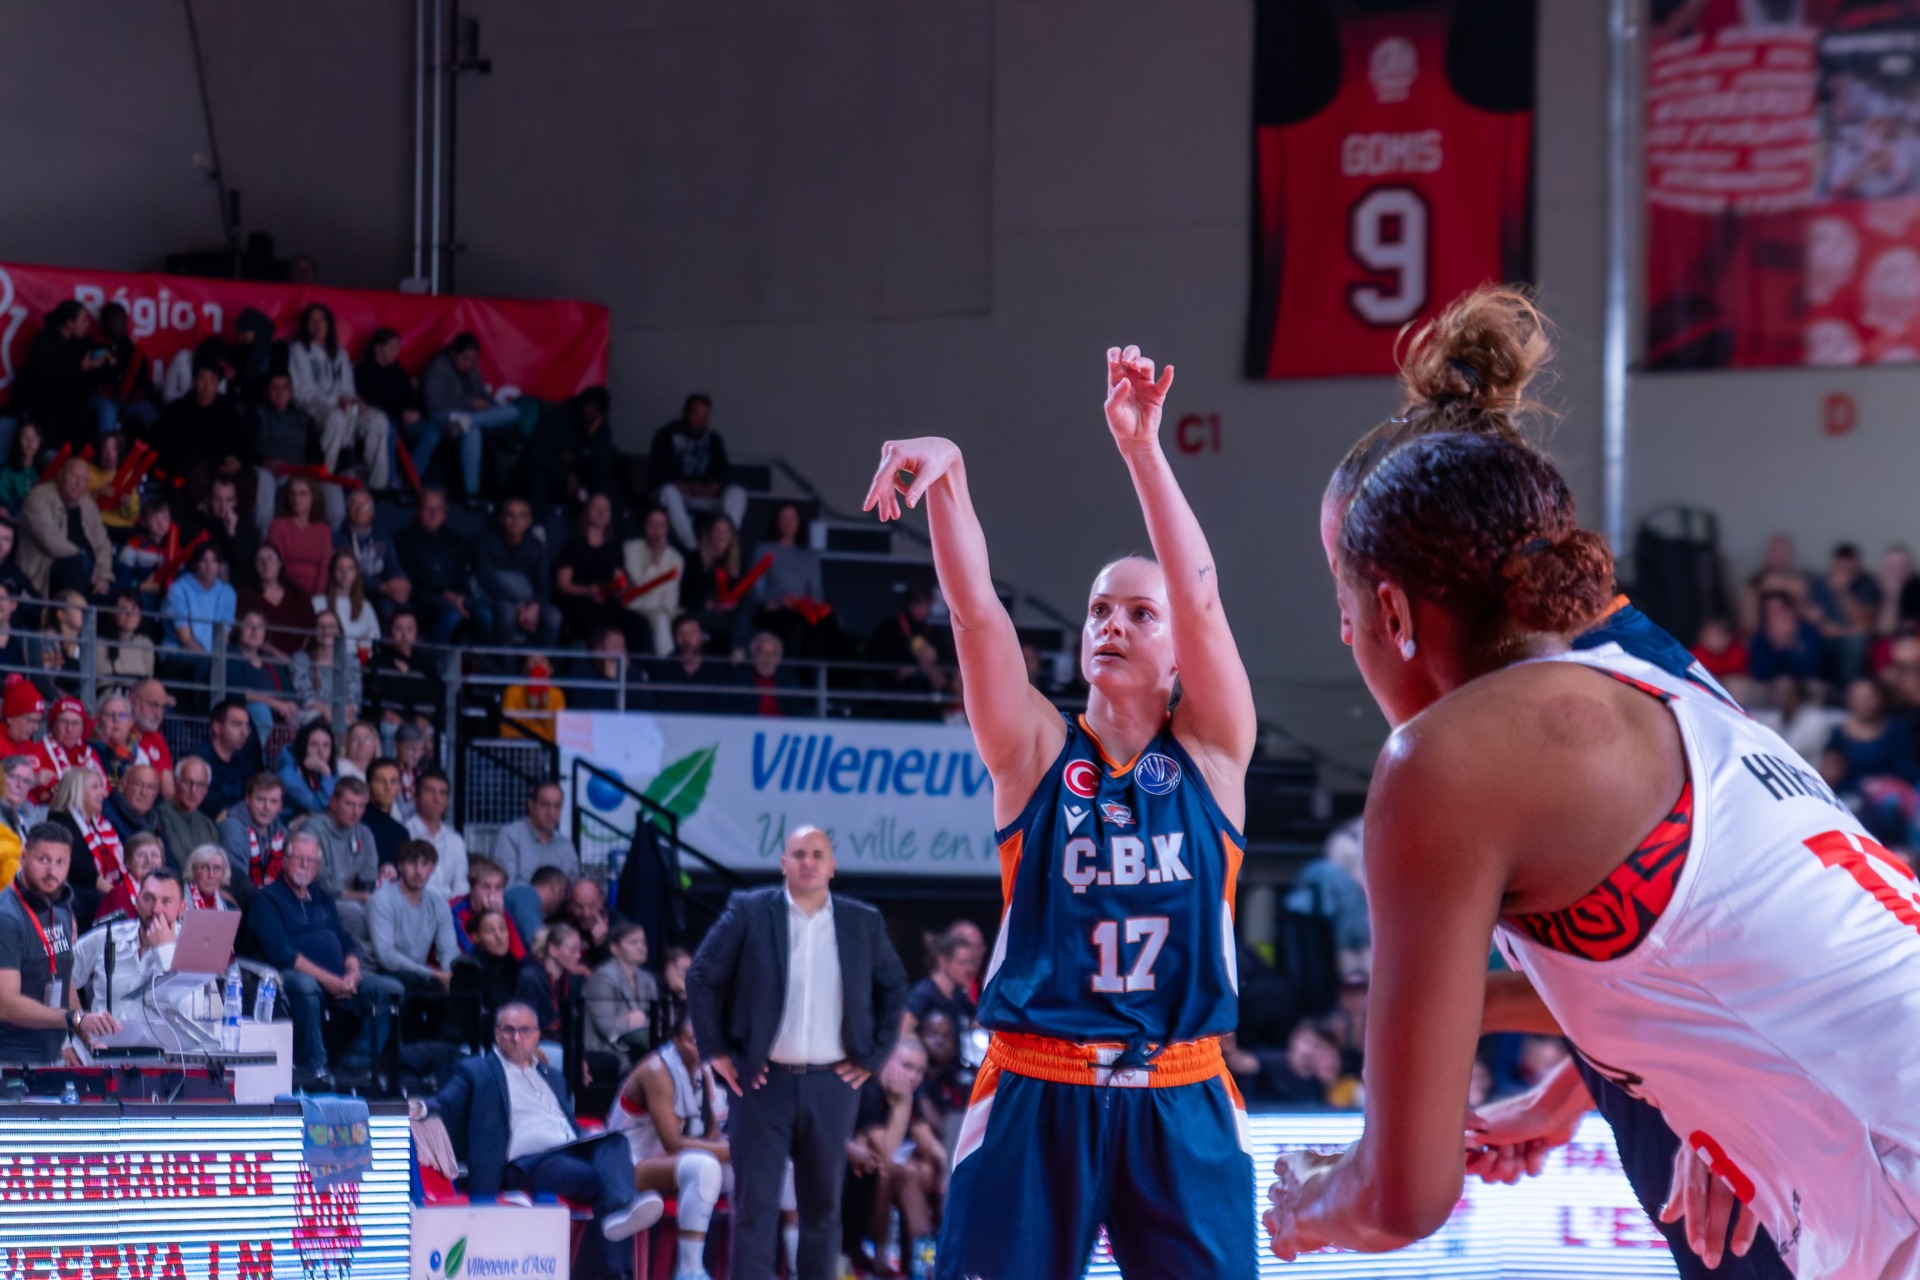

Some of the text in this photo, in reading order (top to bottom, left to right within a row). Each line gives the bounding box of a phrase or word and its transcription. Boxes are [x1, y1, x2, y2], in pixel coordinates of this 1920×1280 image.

[1341, 128, 1443, 176] GOMIS
[1350, 187, 1430, 326] 9
[1177, 413, 1222, 455] C1
[849, 816, 920, 861] ville
[929, 830, 974, 861] en
[1091, 916, 1170, 993] 17
[230, 1151, 273, 1196] DE
[467, 1257, 519, 1277] Villeneuve
